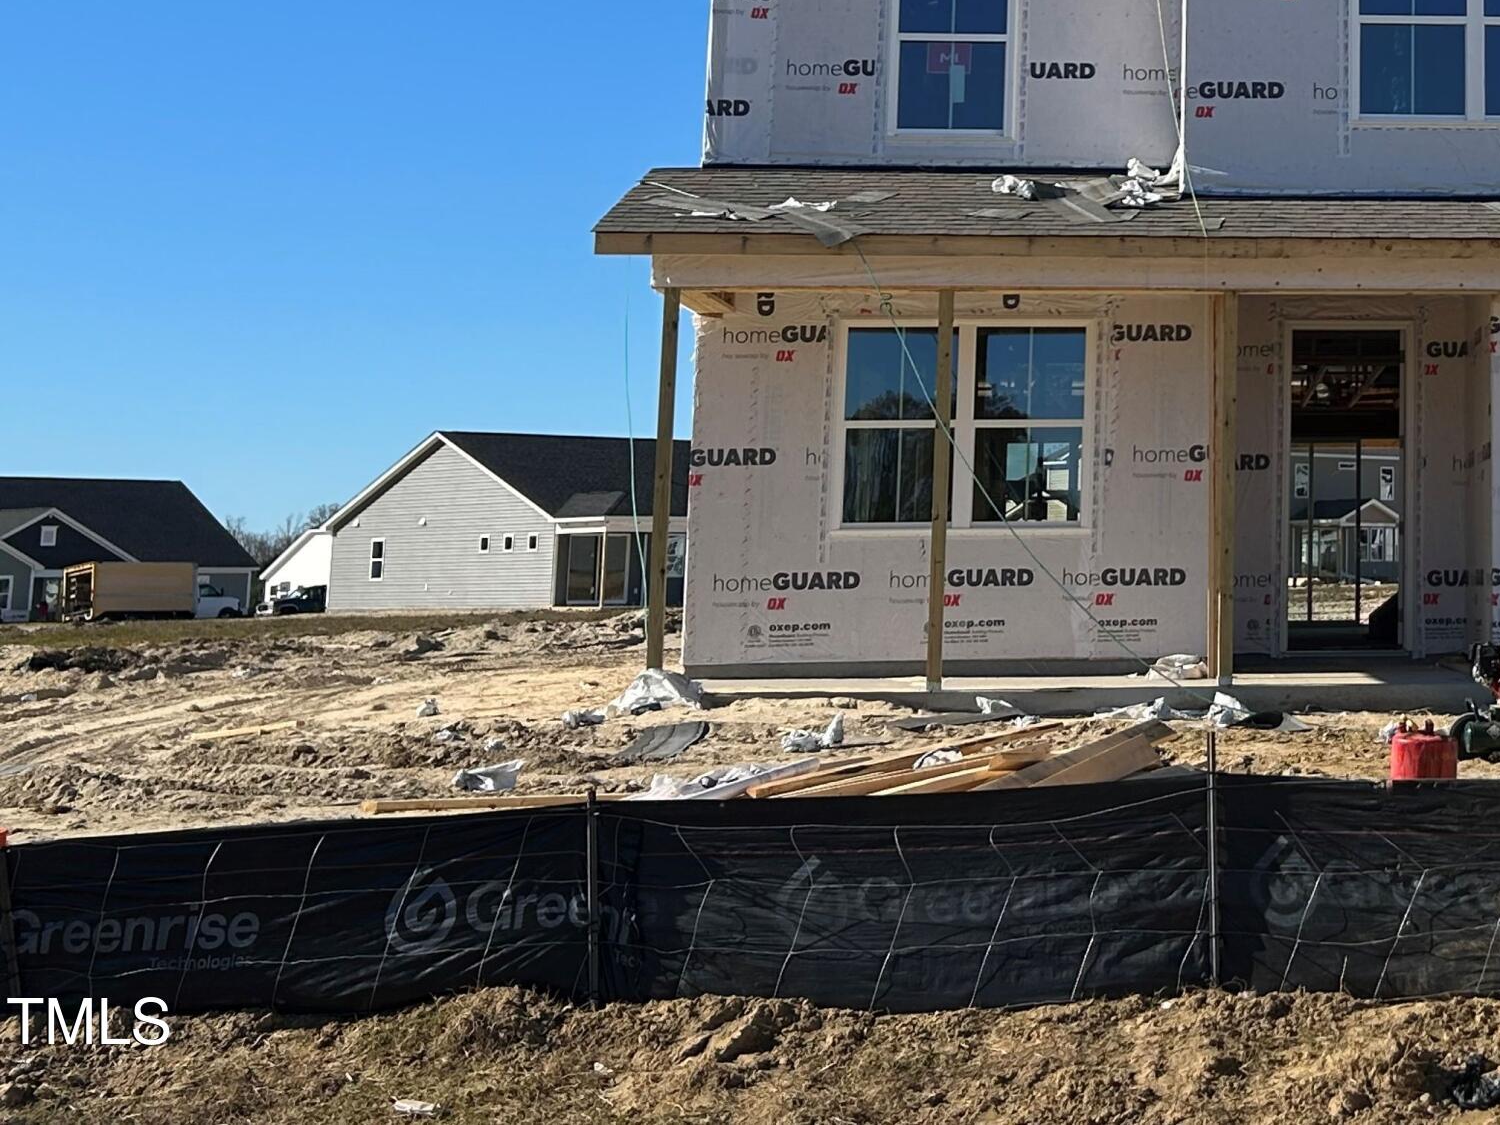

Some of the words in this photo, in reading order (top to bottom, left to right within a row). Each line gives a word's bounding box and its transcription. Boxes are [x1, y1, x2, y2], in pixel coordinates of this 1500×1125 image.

[750, 7, 769, 19] OX
[838, 83, 858, 95] OX
[1195, 106, 1214, 118] OX
[776, 350, 795, 362] OX
[1184, 470, 1203, 482] OX
[713, 571, 860, 594] homeGUARD
[767, 597, 786, 611] OX
[943, 594, 960, 606] OX
[1095, 593, 1113, 606] OX
[768, 621, 831, 633] oxep.com
[944, 617, 1005, 629] oxep.com
[1098, 617, 1157, 628] oxep.com
